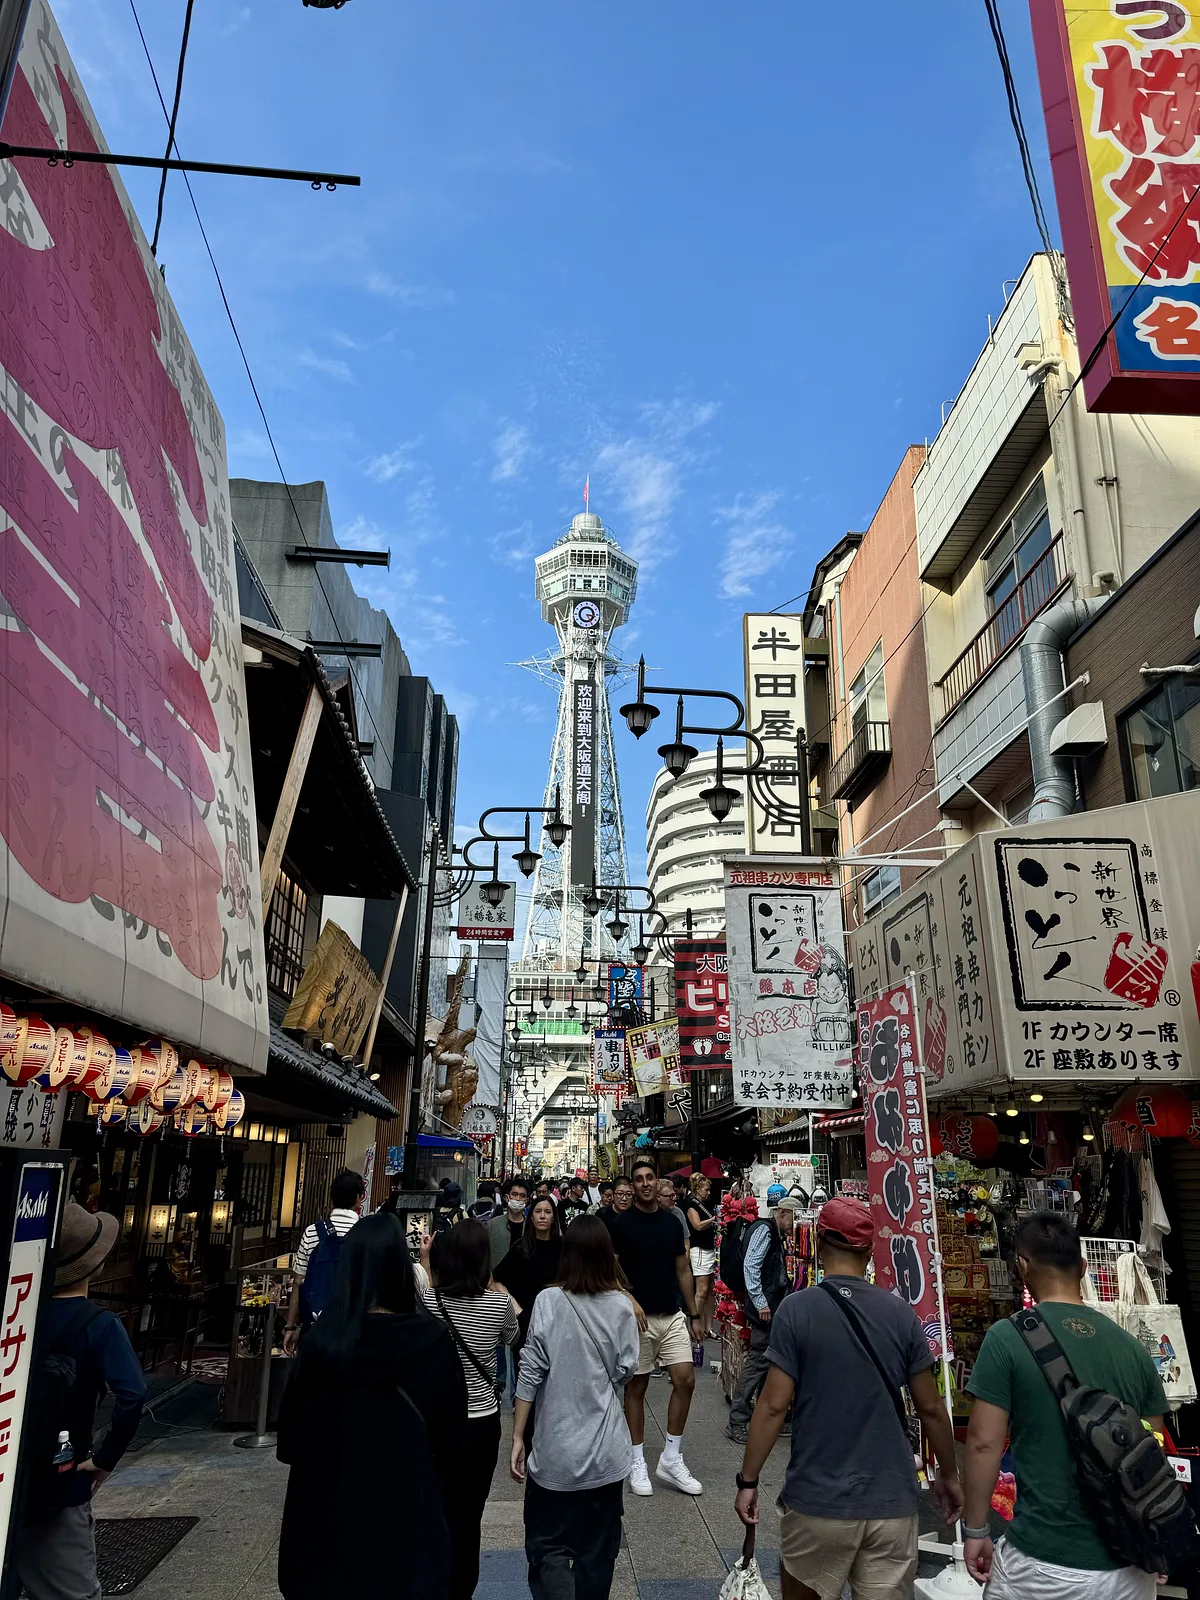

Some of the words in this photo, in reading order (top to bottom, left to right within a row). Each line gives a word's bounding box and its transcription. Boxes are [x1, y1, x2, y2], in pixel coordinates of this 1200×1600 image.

[752, 627, 800, 836] 半田屋酒店
[730, 871, 834, 887] 元祖串カツ専門店
[1091, 860, 1129, 928] 新世界
[1140, 843, 1169, 941] 商標登録
[793, 905, 809, 936] 新世界
[957, 873, 989, 1064] 元祖串カツ
[759, 978, 818, 996] 総本店
[954, 955, 977, 1068] 専門店
[29, 1043, 48, 1051] Asahi
[1022, 1020, 1042, 1041] 1F
[1049, 1020, 1179, 1044] カウンター席
[54, 1036, 69, 1073] アサヒビール
[605, 1040, 619, 1072] 串カツ
[1023, 1049, 1046, 1068] 2F
[1052, 1048, 1183, 1071] 座敷あります
[739, 1081, 850, 1102] 宴会予約受付中
[843, 1181, 868, 1192] OSAK
[17, 1190, 49, 1219] Asahi
